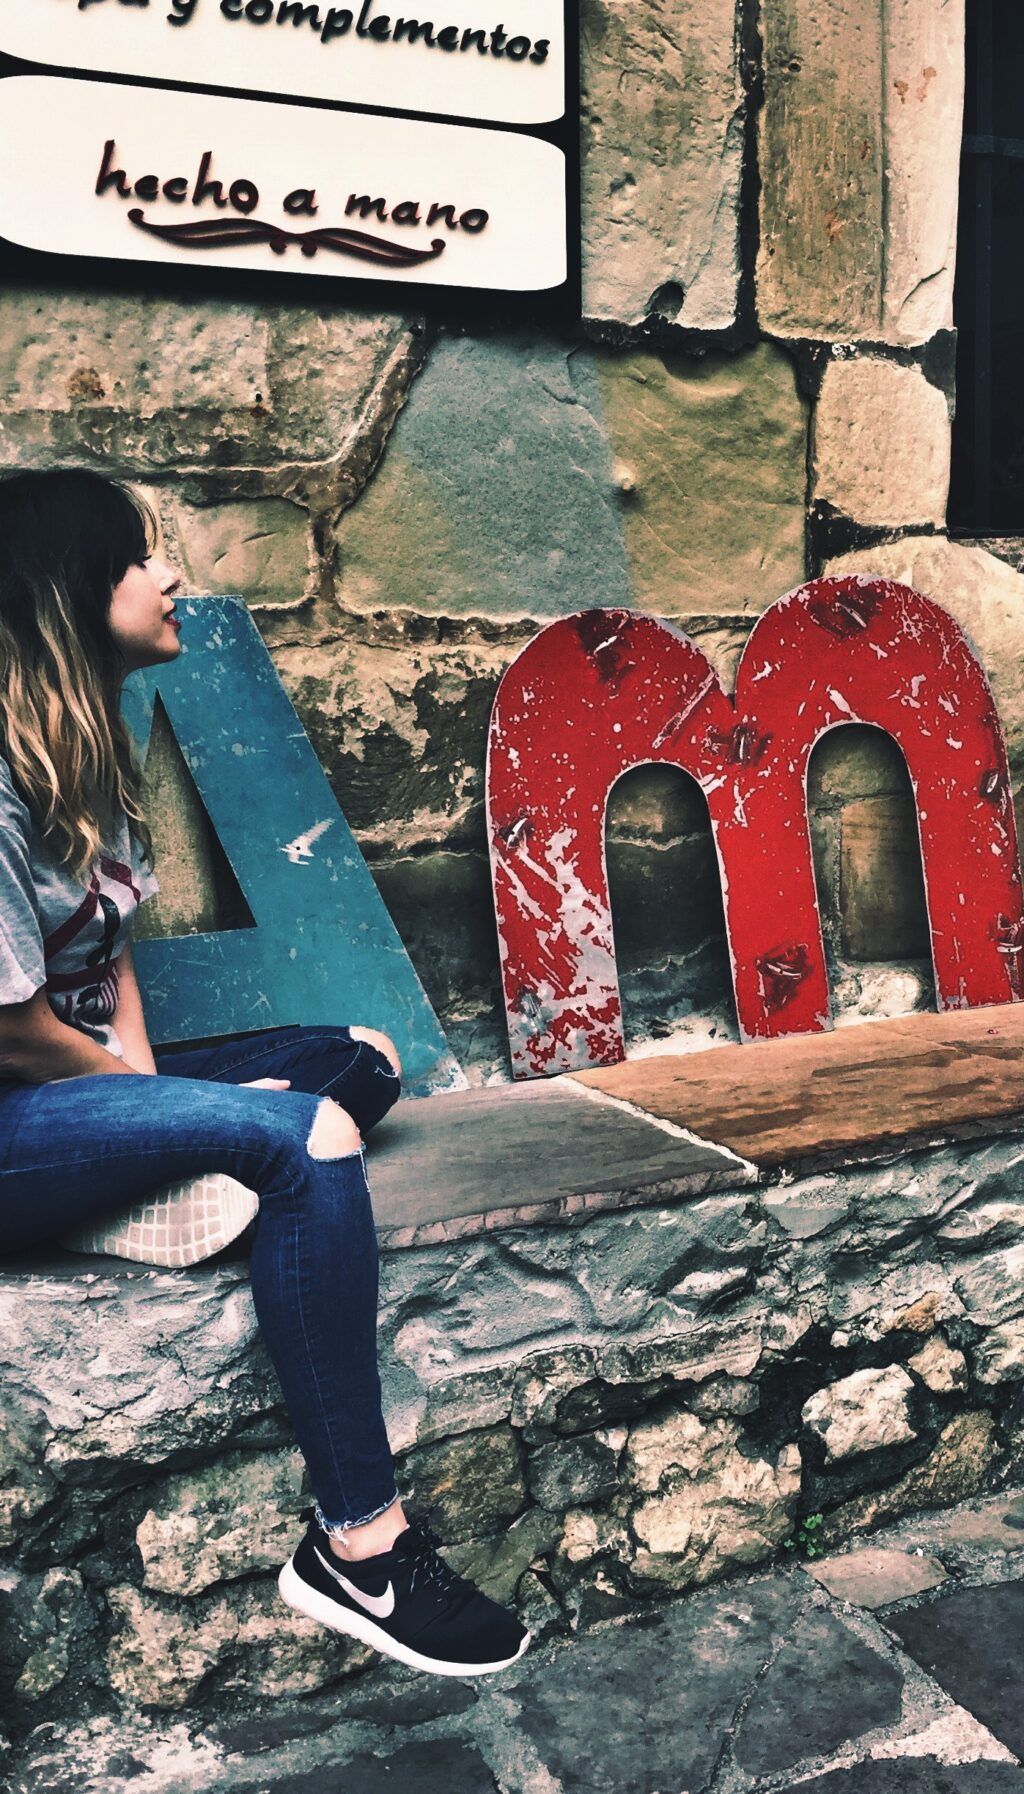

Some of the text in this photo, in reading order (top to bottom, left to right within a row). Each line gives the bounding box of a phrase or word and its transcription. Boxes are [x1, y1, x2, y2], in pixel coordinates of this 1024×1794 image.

[219, 0, 551, 65] complementos
[94, 139, 489, 235] hecho a mano
